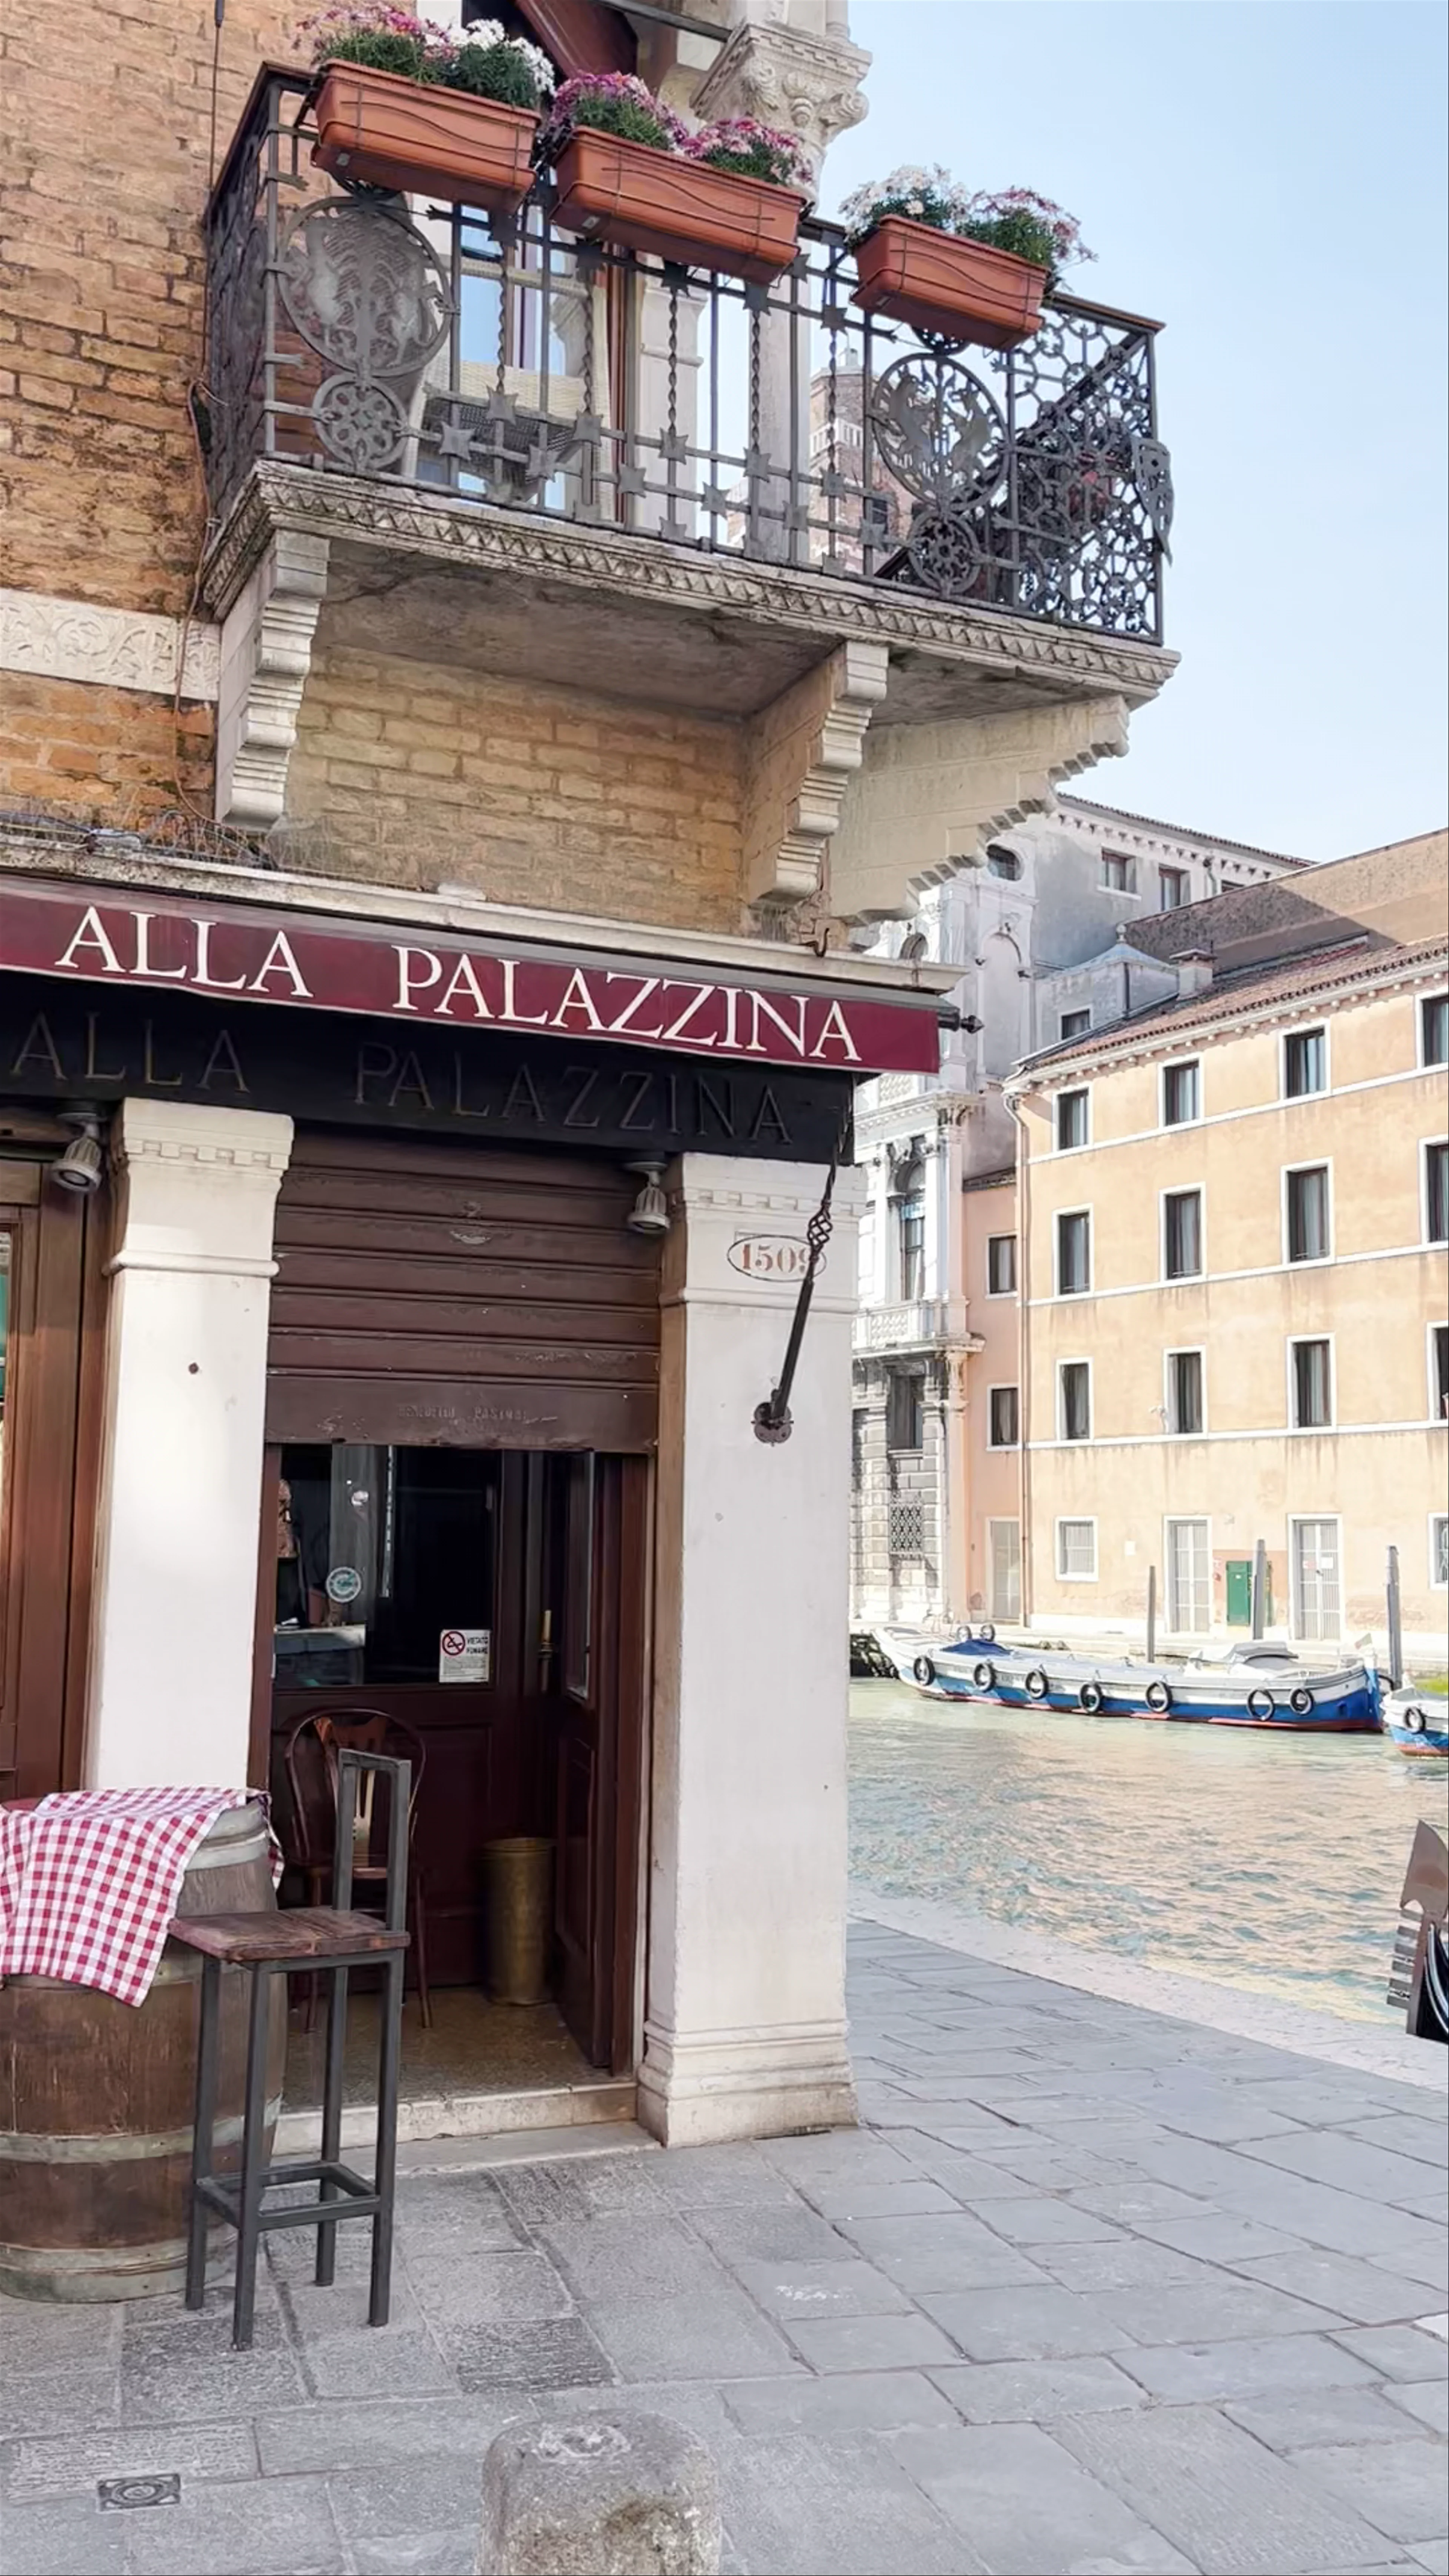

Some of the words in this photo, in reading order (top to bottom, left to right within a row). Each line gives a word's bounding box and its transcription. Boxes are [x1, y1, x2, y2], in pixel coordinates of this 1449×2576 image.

[55, 906, 314, 998] ALLA
[391, 944, 863, 1062] PALAZZINA
[10, 1011, 251, 1093] ALLA
[354, 1041, 792, 1144] PALAZZINA
